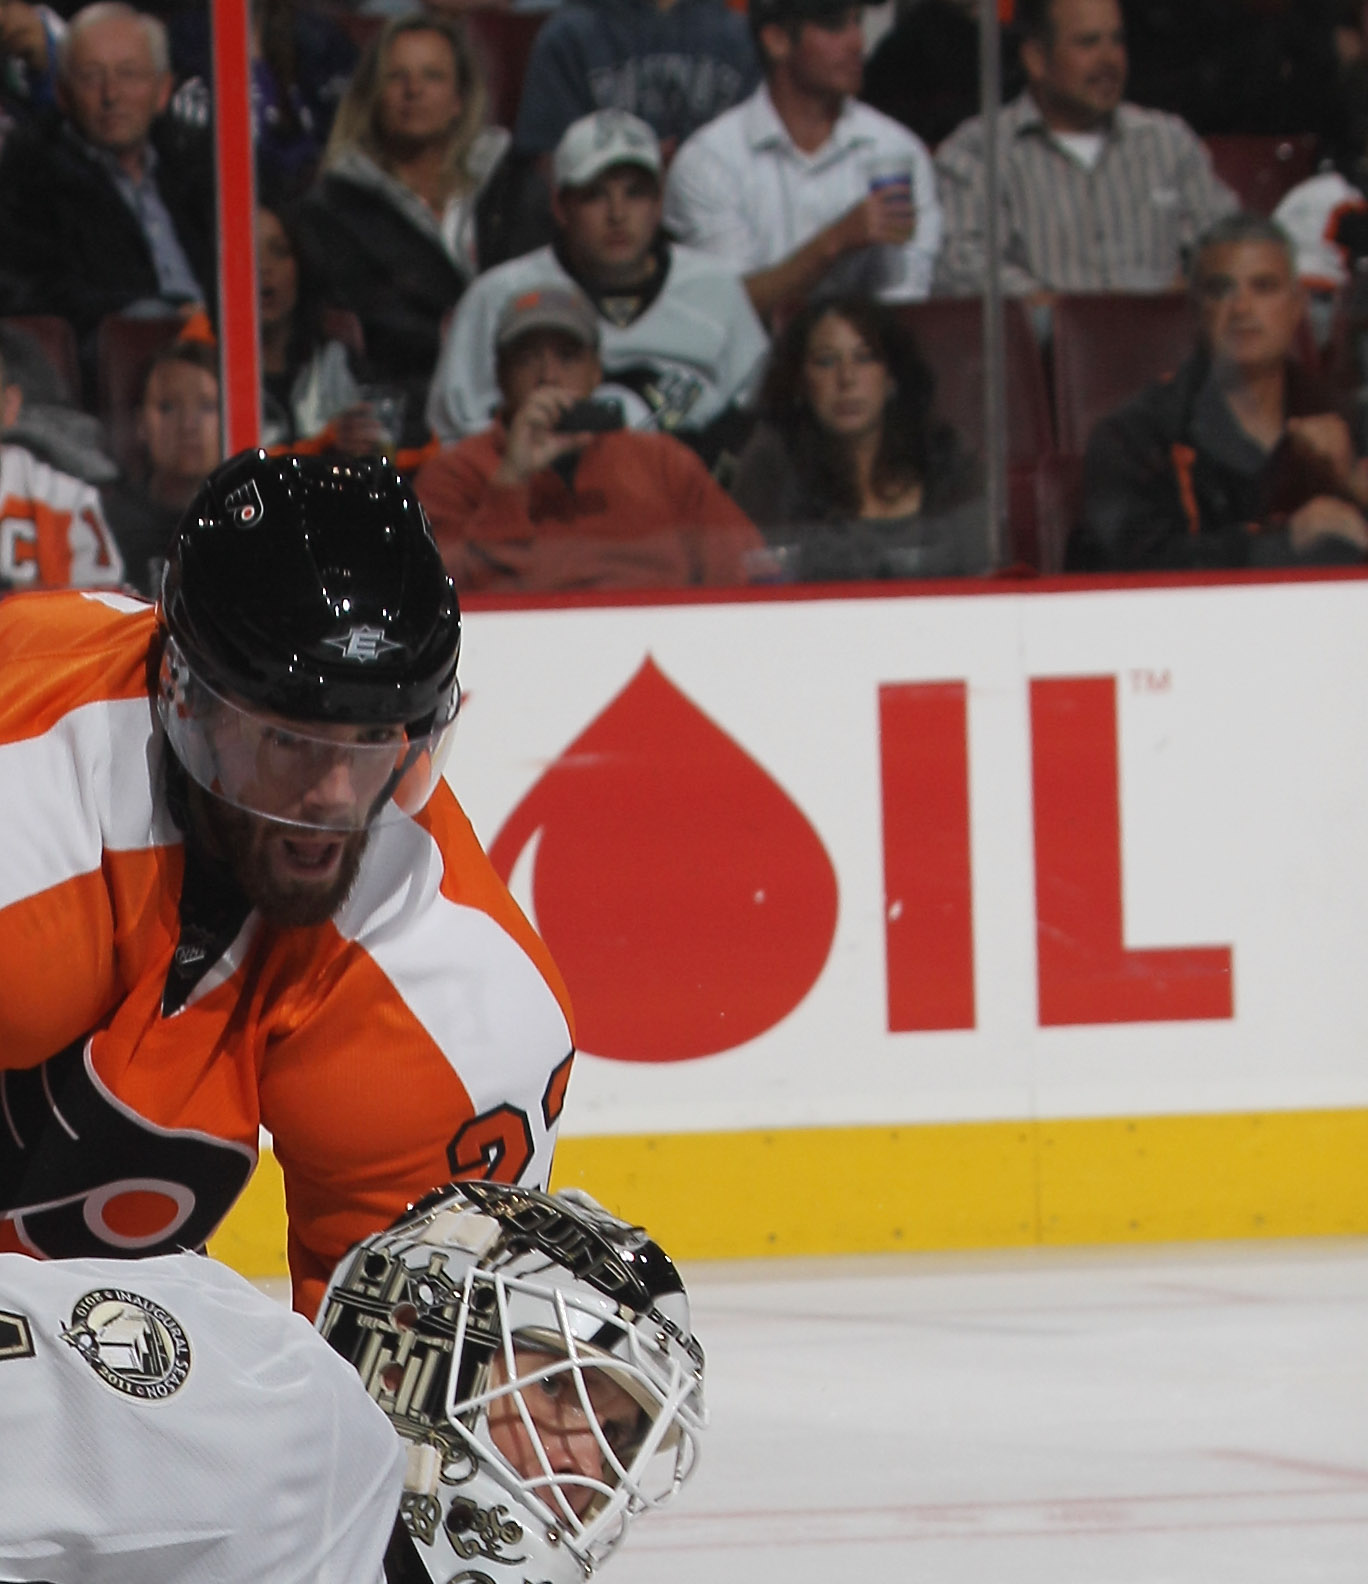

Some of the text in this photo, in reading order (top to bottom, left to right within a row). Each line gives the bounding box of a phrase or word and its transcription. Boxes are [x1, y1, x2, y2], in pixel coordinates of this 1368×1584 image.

[115, 1289, 189, 1356] INAUGURAL
[97, 1365, 134, 1393] 2011
[144, 1359, 190, 1399] SEASON
